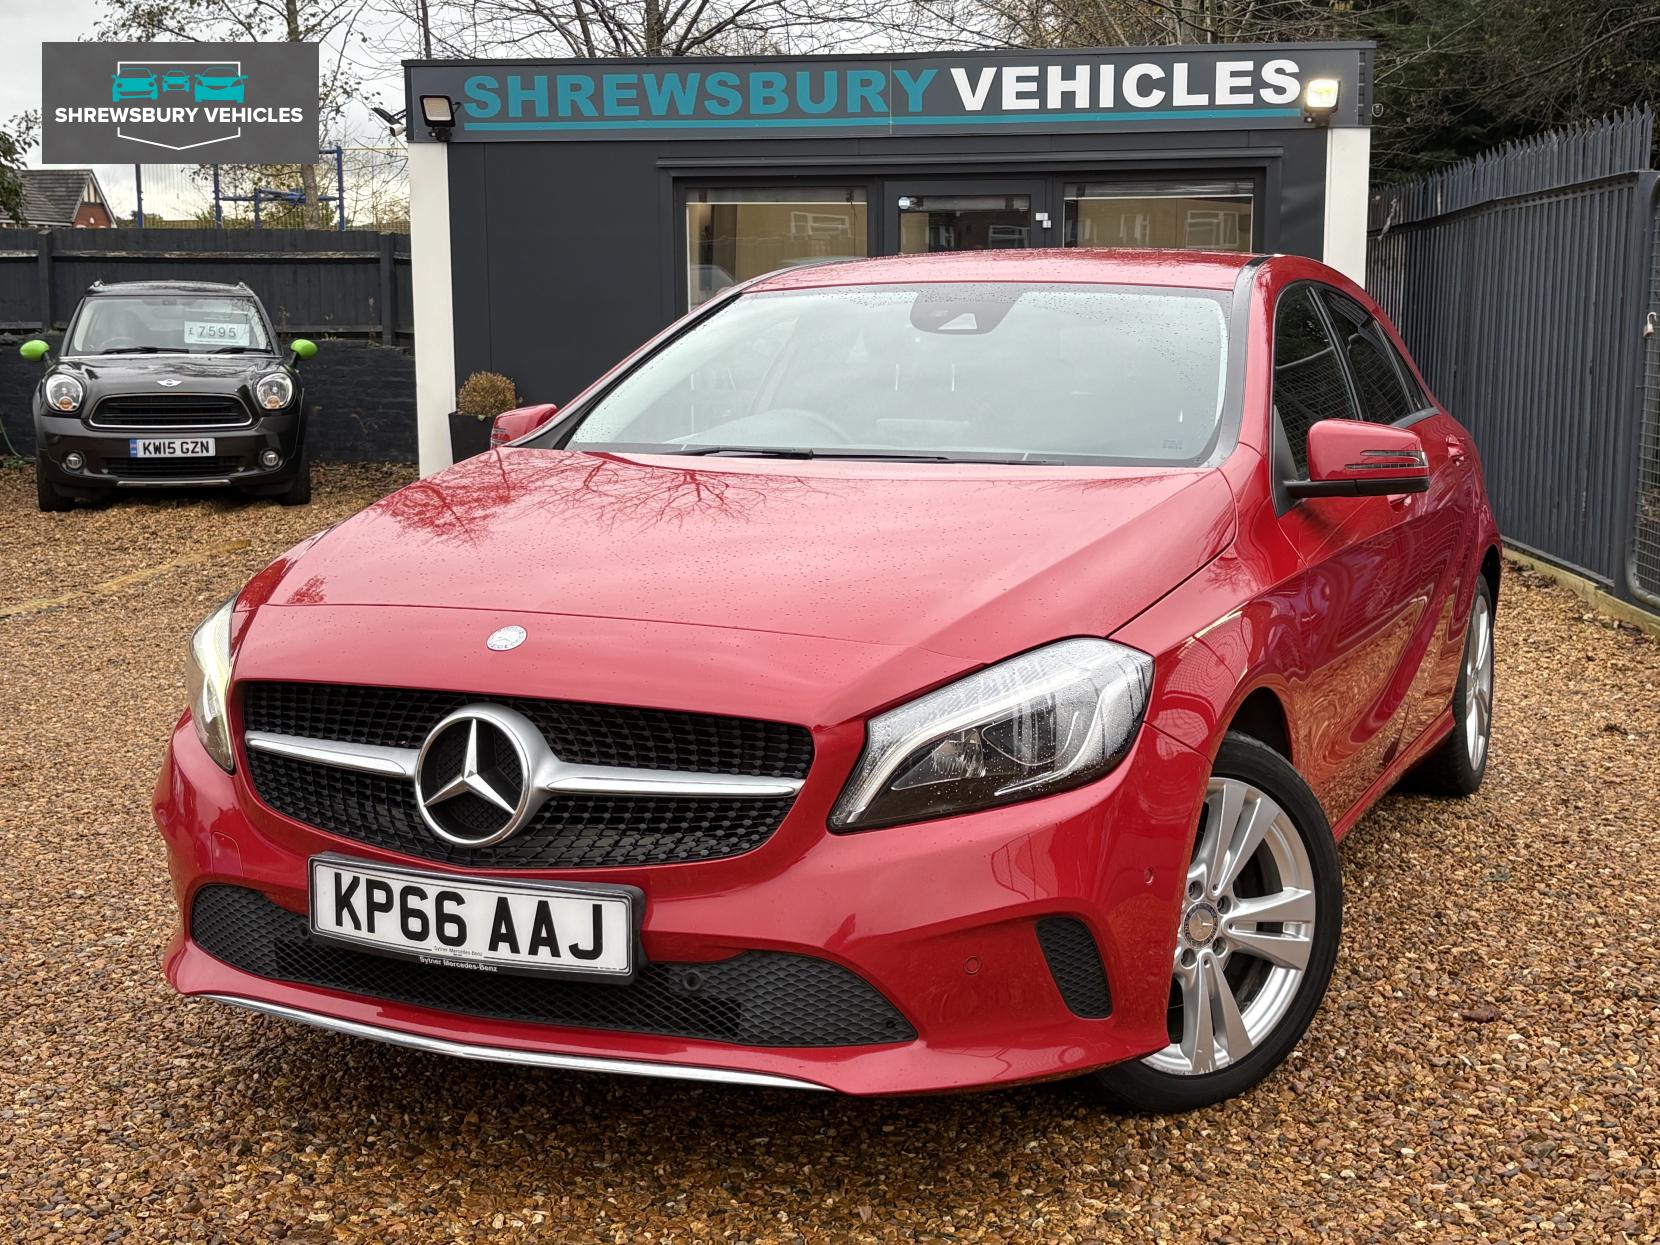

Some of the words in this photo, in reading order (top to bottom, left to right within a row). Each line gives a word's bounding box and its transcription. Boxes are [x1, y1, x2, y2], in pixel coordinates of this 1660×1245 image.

[463, 69, 939, 118] SHREWSBURY
[950, 59, 1301, 112] VEHICLES
[142, 441, 176, 455] KW15
[180, 440, 210, 454] GZN
[334, 872, 468, 947] KP66
[488, 896, 603, 960] AAJ
